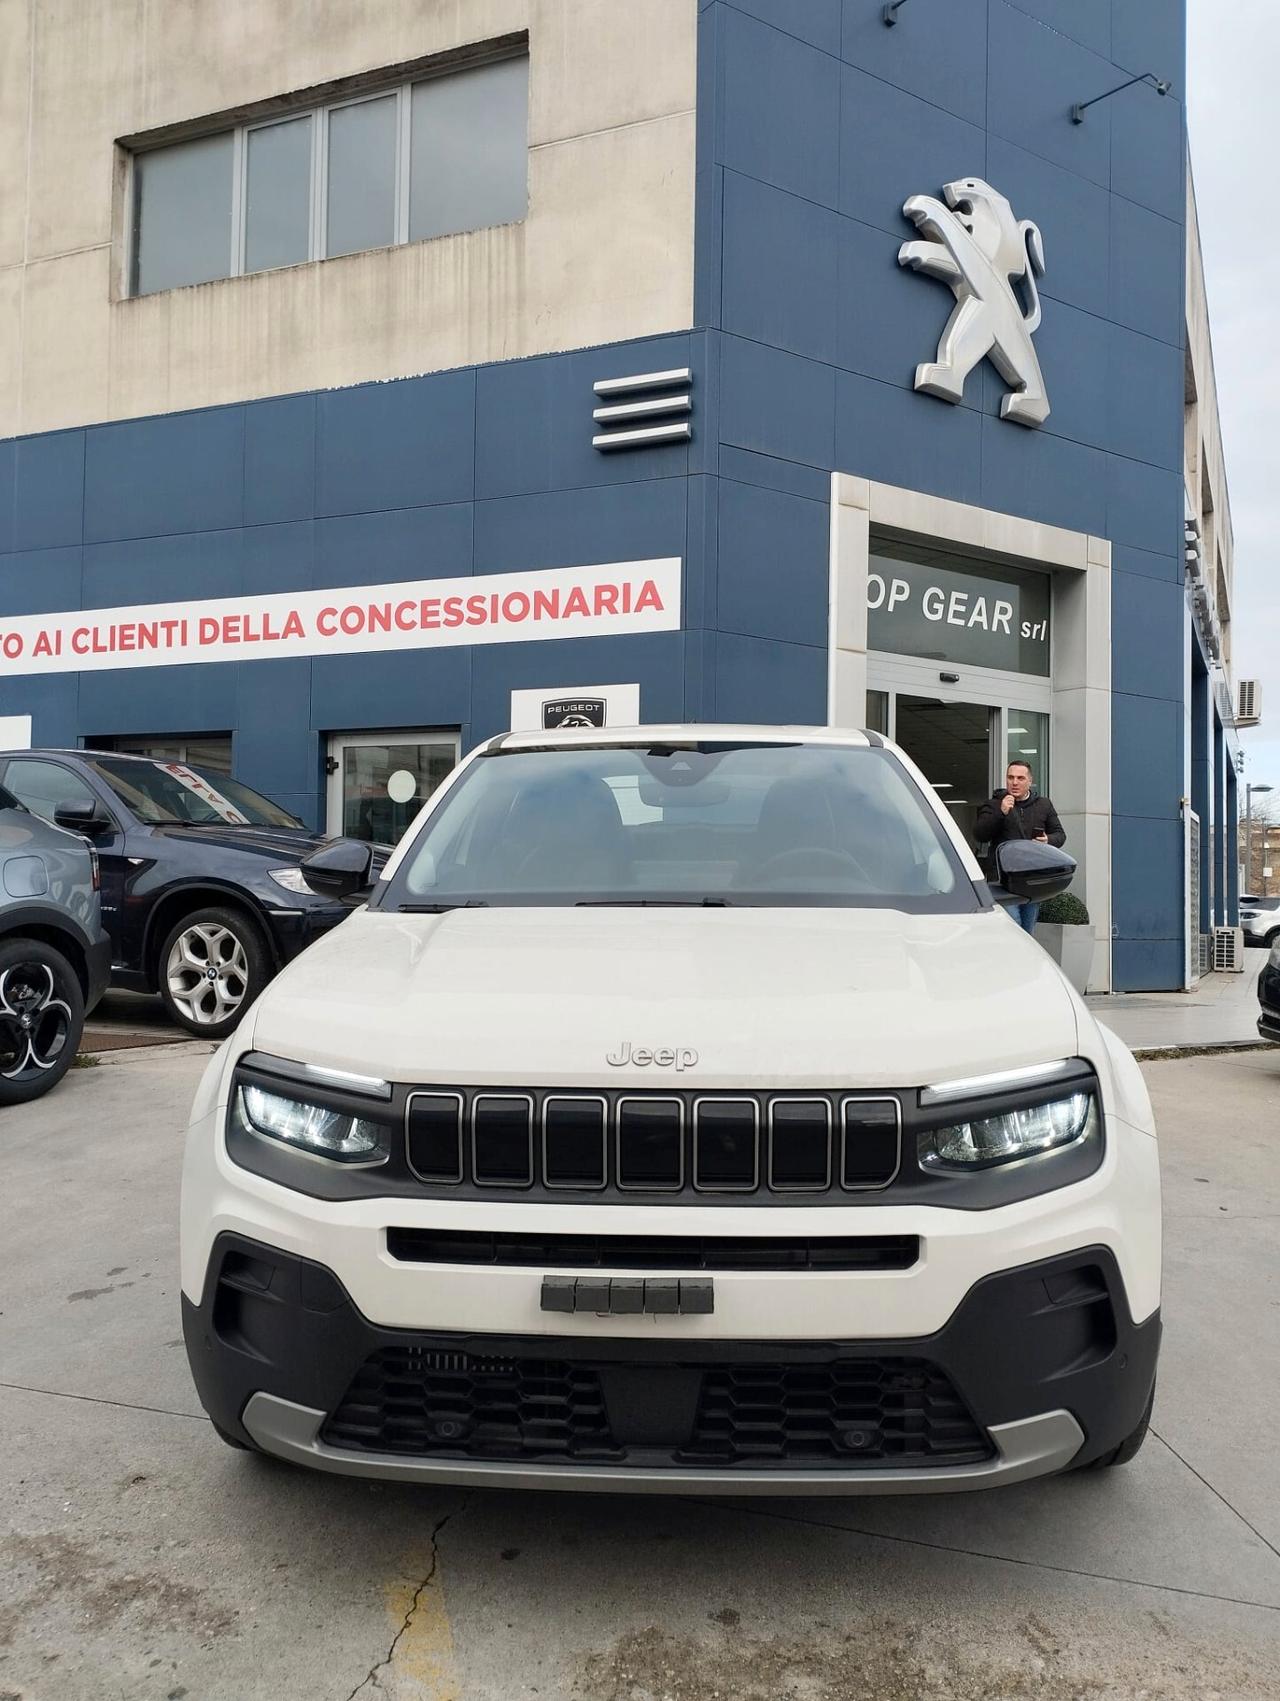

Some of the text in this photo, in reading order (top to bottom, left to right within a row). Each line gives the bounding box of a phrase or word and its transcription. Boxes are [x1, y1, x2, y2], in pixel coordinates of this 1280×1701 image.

[0, 580, 665, 659] O AI CLIENTI DELLA CONCESSIONARIA
[922, 586, 1013, 634] GEAR
[1020, 620, 1047, 641] srl
[547, 704, 601, 714] PEUGEOT
[606, 1041, 699, 1072] Jeep
